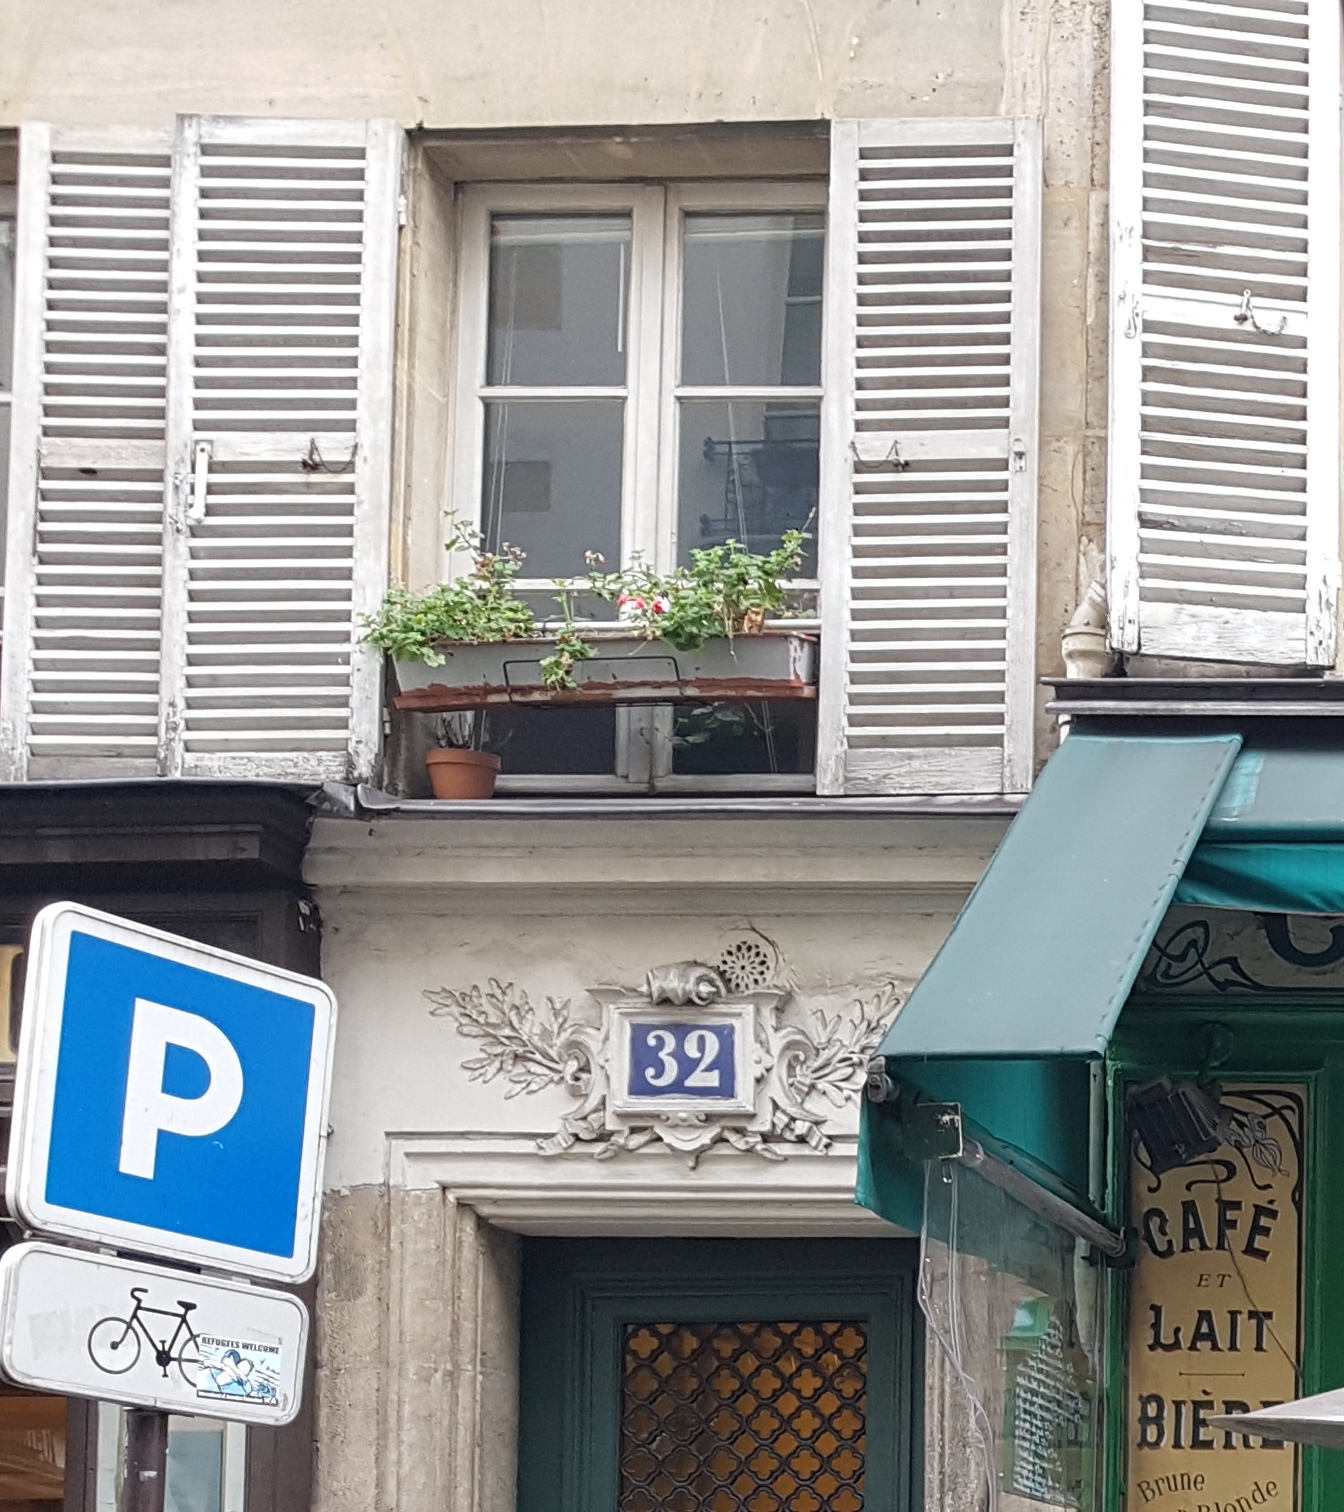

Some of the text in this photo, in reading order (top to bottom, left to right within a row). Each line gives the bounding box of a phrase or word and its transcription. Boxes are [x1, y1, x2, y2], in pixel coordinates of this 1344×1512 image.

[643, 1028, 723, 1090] 32
[118, 996, 245, 1181] P
[1142, 1197, 1280, 1263] CAFÉ
[1196, 1273, 1232, 1288] ET
[202, 1336, 280, 1355] REFUGEES WELCOME
[1147, 1303, 1275, 1354] LAIT
[1137, 1470, 1206, 1505] Brune
